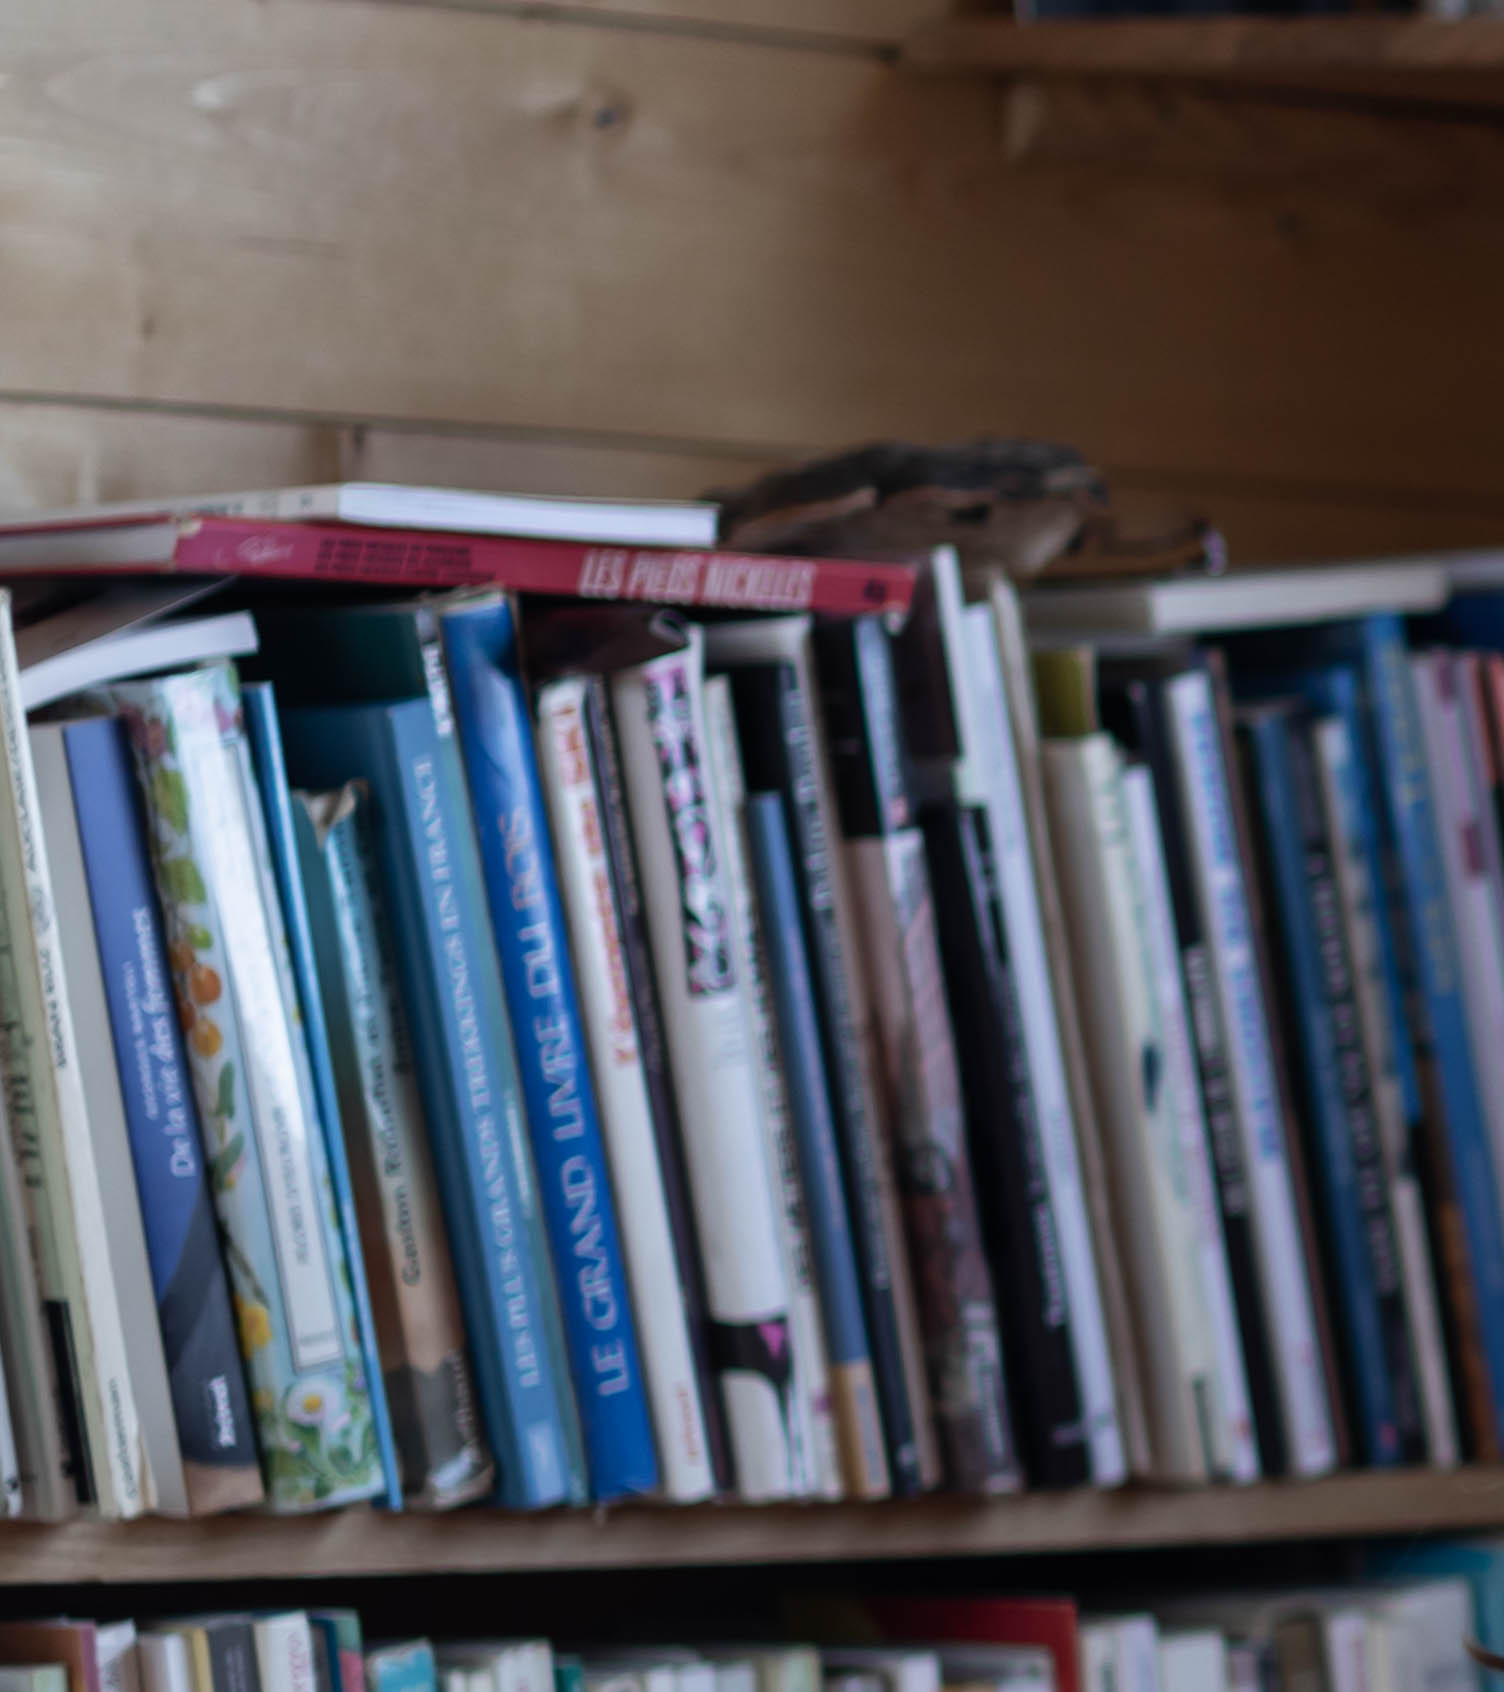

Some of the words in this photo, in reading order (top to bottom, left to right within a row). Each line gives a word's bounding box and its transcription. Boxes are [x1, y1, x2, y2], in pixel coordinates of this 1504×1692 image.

[580, 550, 628, 600] LES
[626, 552, 701, 606] PIEDS
[415, 758, 451, 881] FRANCE
[498, 805, 545, 912] BOIS
[436, 883, 459, 930] EN
[133, 906, 170, 1014] femmes
[518, 921, 560, 998] DU
[152, 1015, 175, 1062] des
[445, 933, 491, 1112] TREKKINGS
[160, 1065, 183, 1103] vie
[534, 1014, 586, 1142] LIVRE
[163, 1104, 187, 1136] la
[170, 1137, 196, 1178] De
[475, 1115, 514, 1248] GRANDS
[395, 1185, 422, 1288] Gaston
[561, 1154, 618, 1331] GRAND
[503, 1248, 530, 1330] PLUS
[515, 1331, 540, 1388] LES
[592, 1338, 630, 1397] LE
